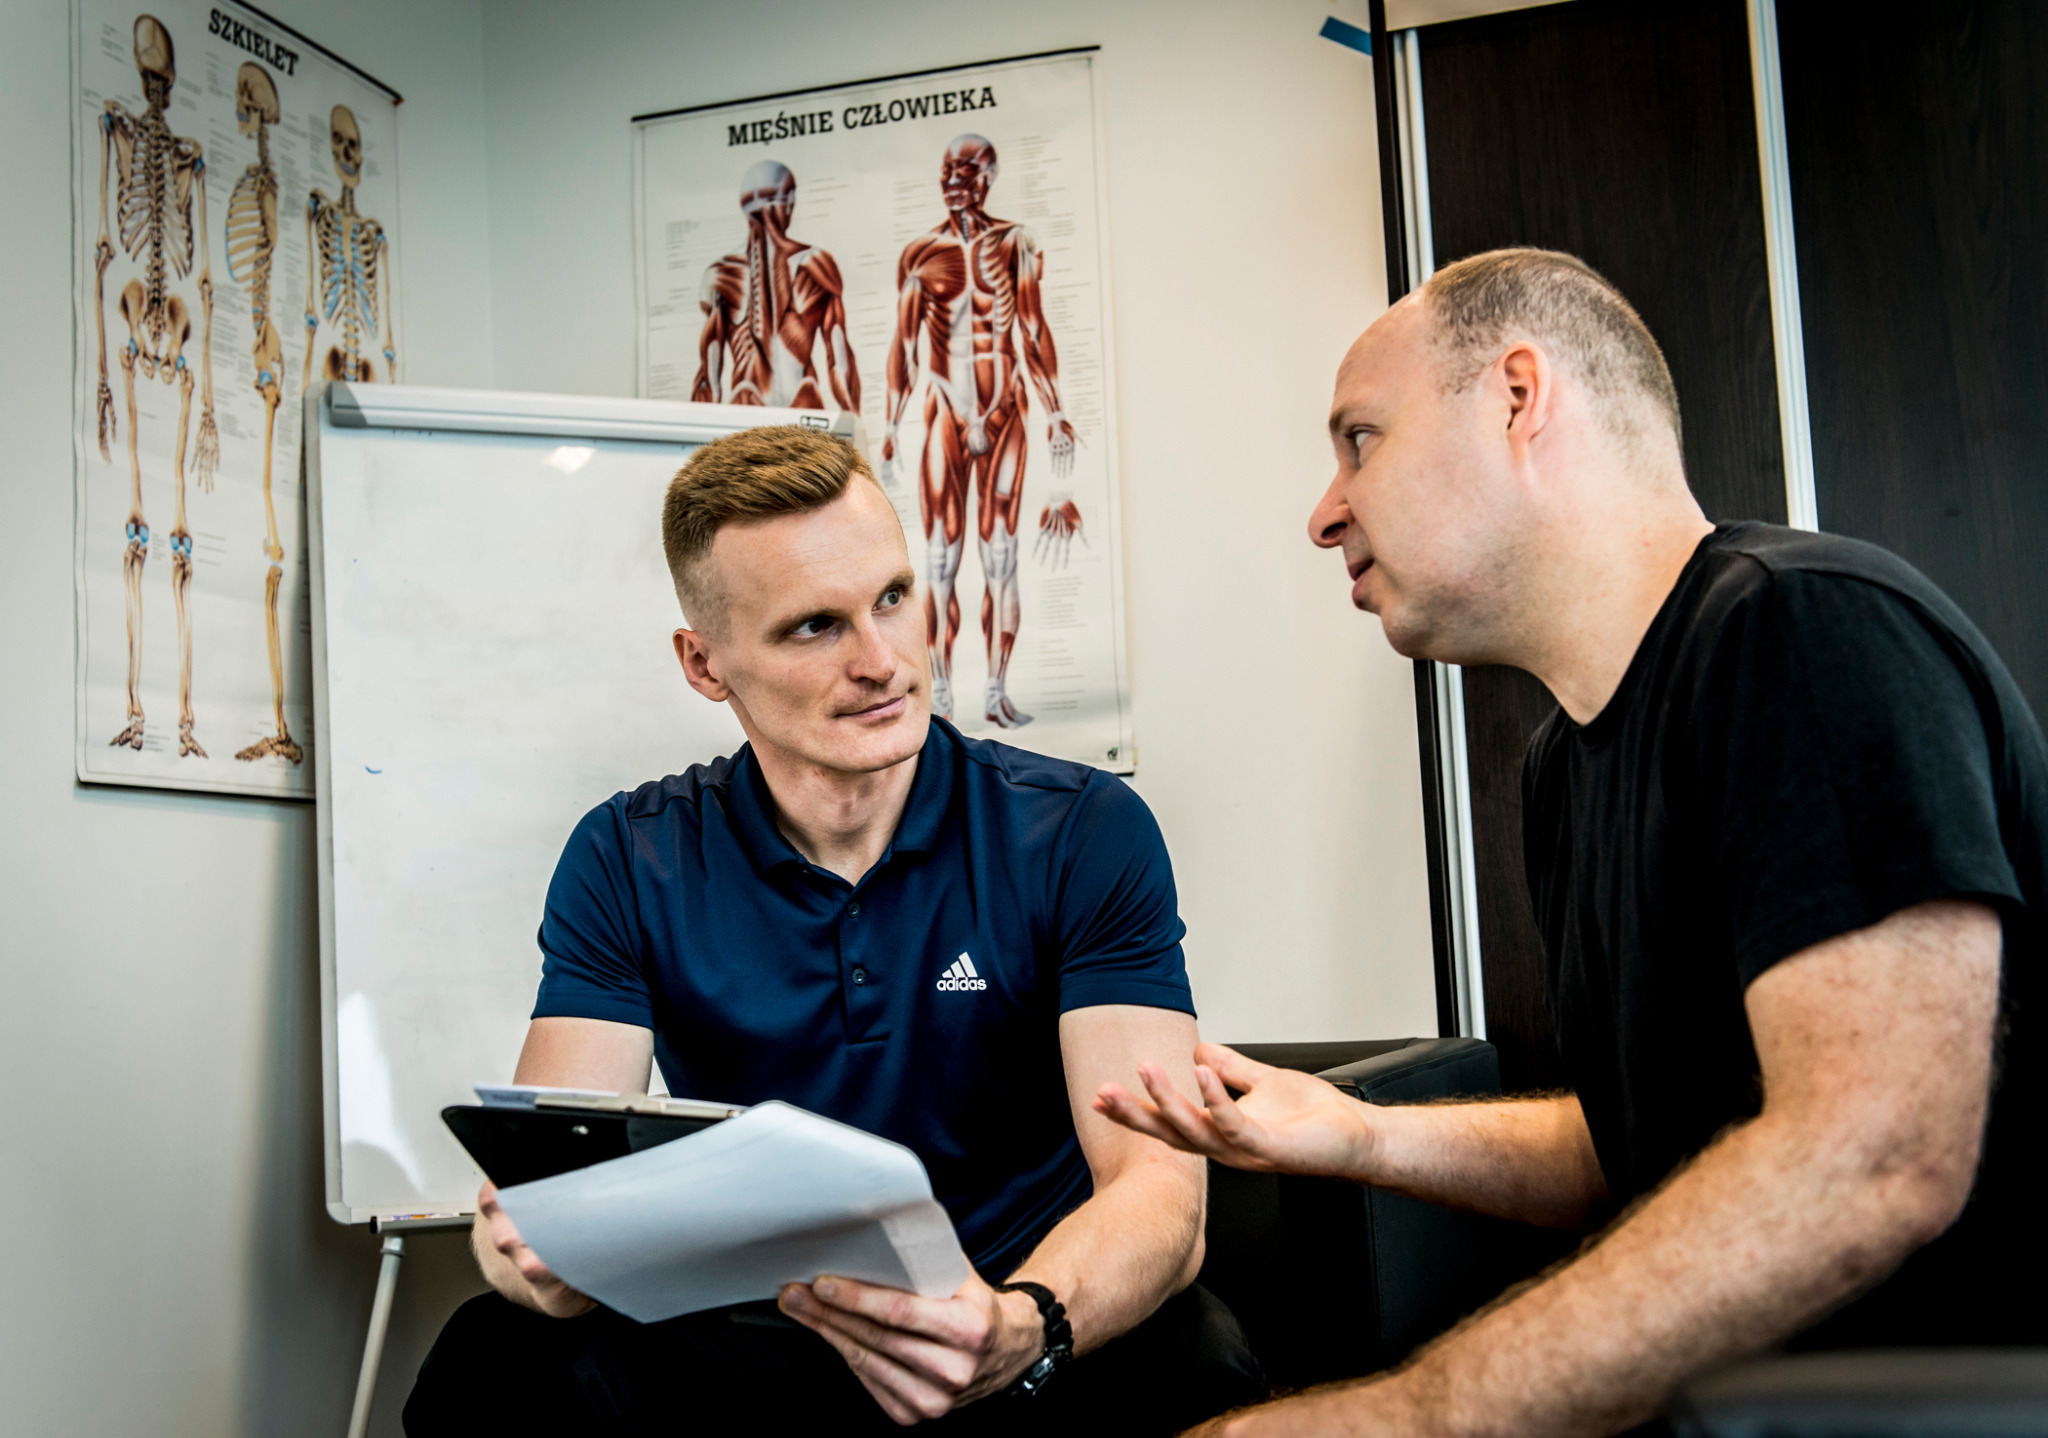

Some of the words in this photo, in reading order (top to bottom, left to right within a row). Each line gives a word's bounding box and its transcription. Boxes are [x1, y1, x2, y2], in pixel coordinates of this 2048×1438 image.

[208, 7, 299, 76] SZKIELET
[728, 110, 834, 147] MIĘŚNIE
[843, 86, 998, 130] CZŁOWIEKA
[936, 976, 987, 991] adidas
